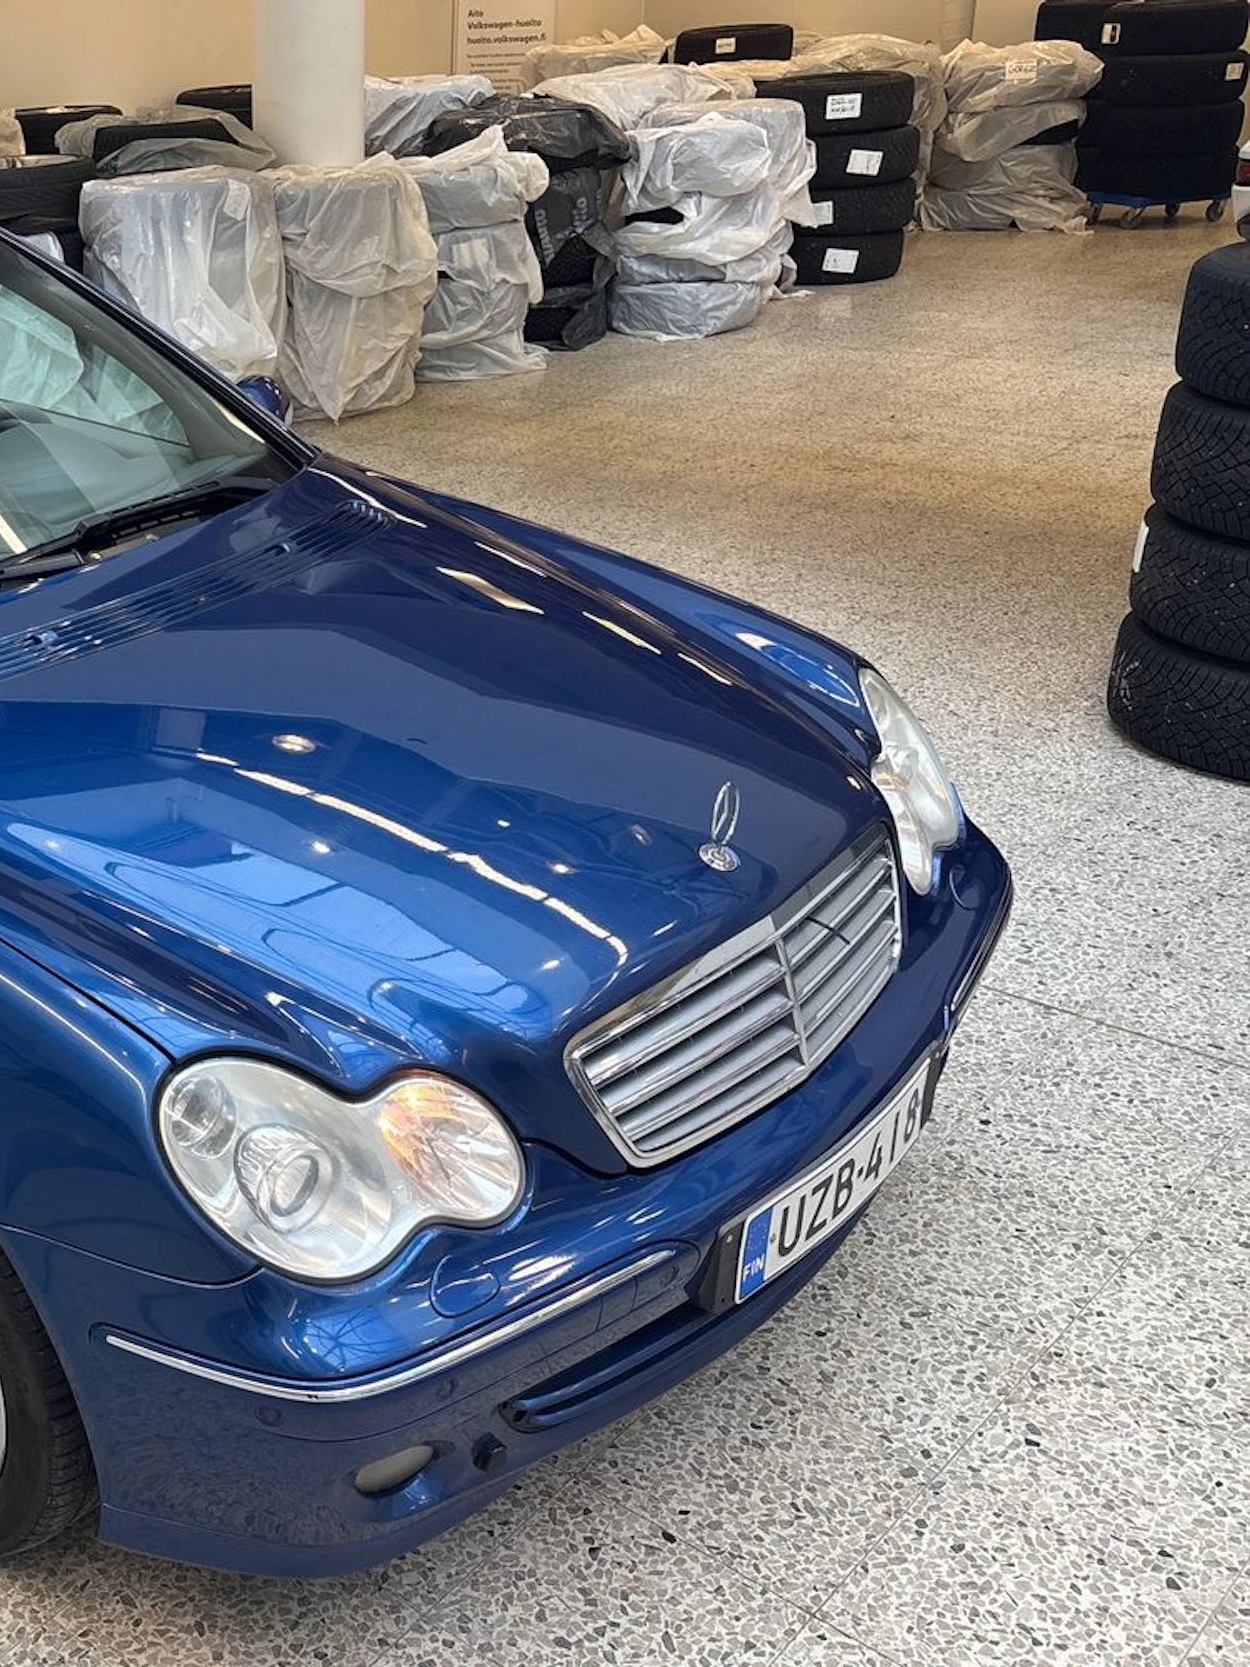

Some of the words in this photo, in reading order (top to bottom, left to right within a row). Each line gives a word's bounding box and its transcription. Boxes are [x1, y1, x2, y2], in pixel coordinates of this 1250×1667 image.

[467, 19, 542, 30] Volkswagen-huolto
[466, 32, 546, 44] huolto.volkswagen.fi
[777, 1088, 922, 1257] UZB-418
[742, 1254, 766, 1282] FIN
